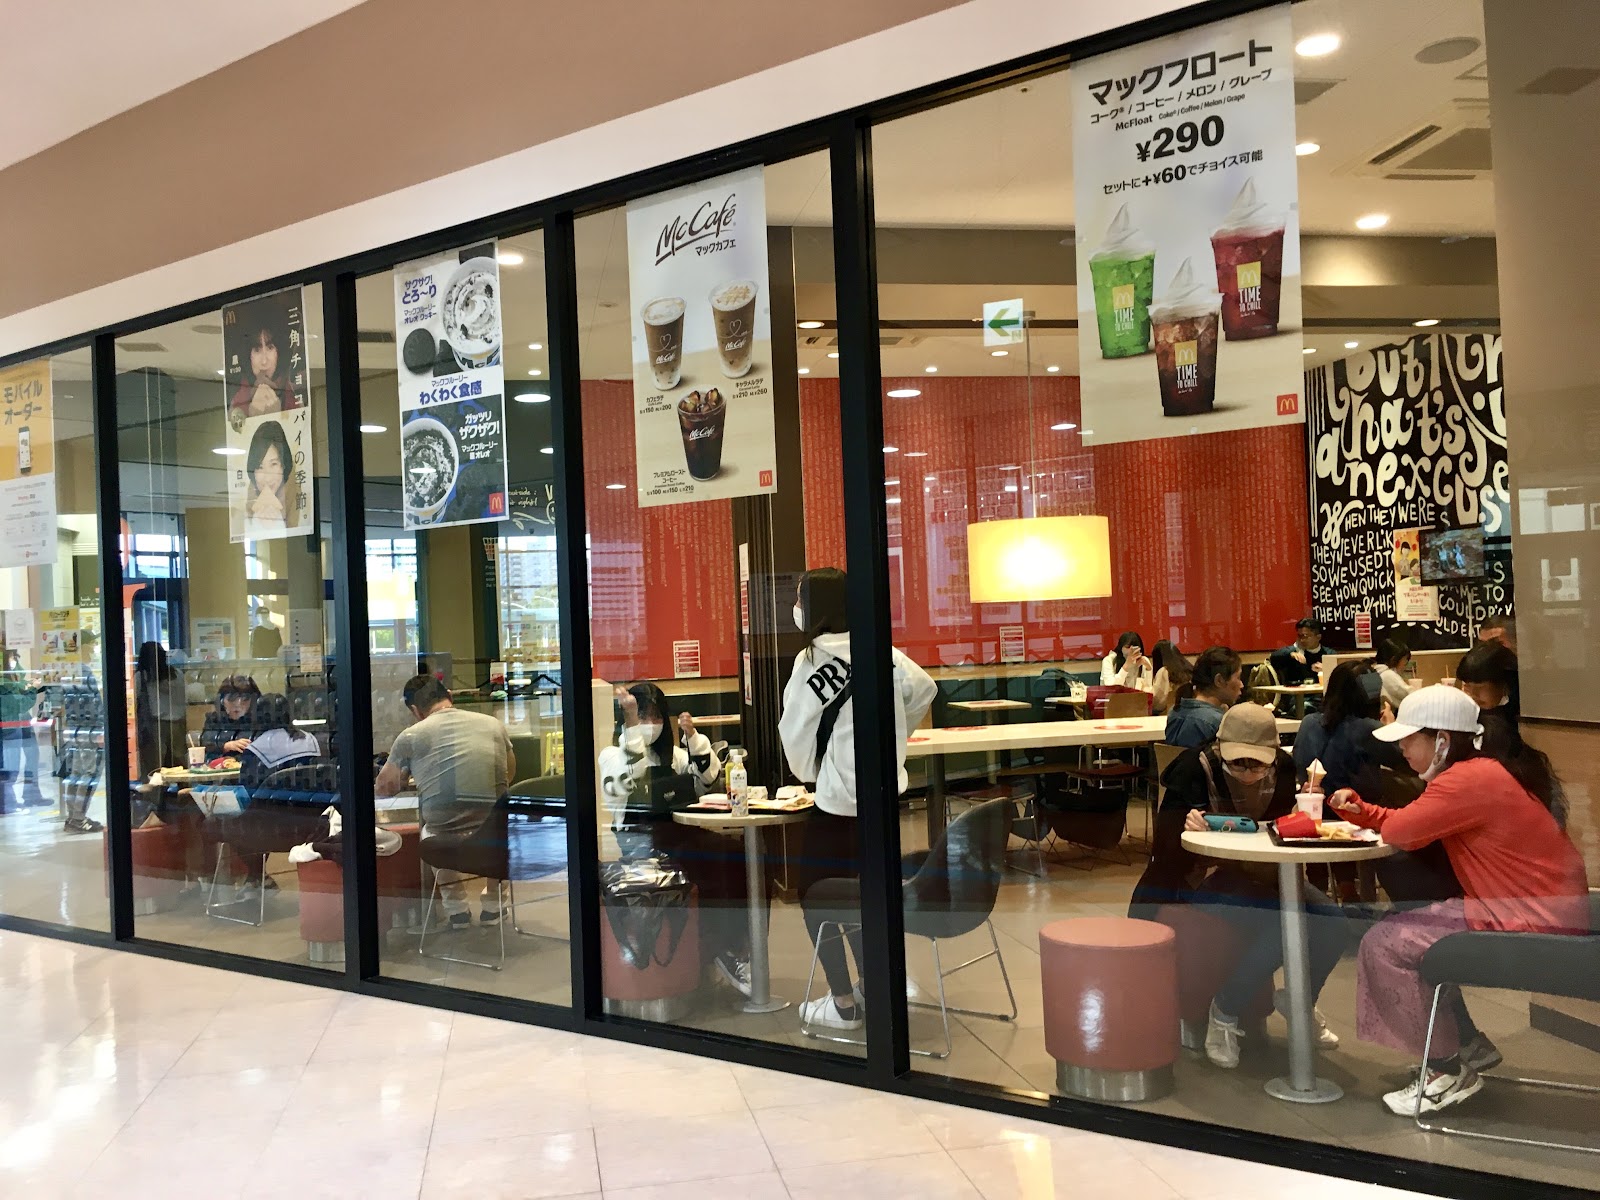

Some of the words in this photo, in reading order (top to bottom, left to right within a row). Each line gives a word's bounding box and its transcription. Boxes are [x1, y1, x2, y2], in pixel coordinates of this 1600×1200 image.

[1088, 39, 1272, 106] マックフロート
[1186, 84, 1216, 100] メロン
[1115, 115, 1153, 131] McFloat
[1135, 115, 1225, 162] ¥290
[656, 193, 736, 258] McCafé
[695, 239, 736, 256] マックカフェ
[1238, 286, 1261, 304] TIME
[1113, 307, 1135, 323] TIME
[1175, 363, 1198, 381] TIME
[1183, 378, 1198, 388] CHILL
[1367, 503, 1396, 528] THEY
[1397, 496, 1435, 526] WERE
[1311, 542, 1336, 574] THEY
[1328, 565, 1348, 588] WE
[1349, 550, 1383, 578] USED
[1312, 584, 1333, 603] SEE
[1335, 578, 1358, 606] HOW
[1483, 584, 1505, 602] TO
[1312, 604, 1343, 624] THEM
